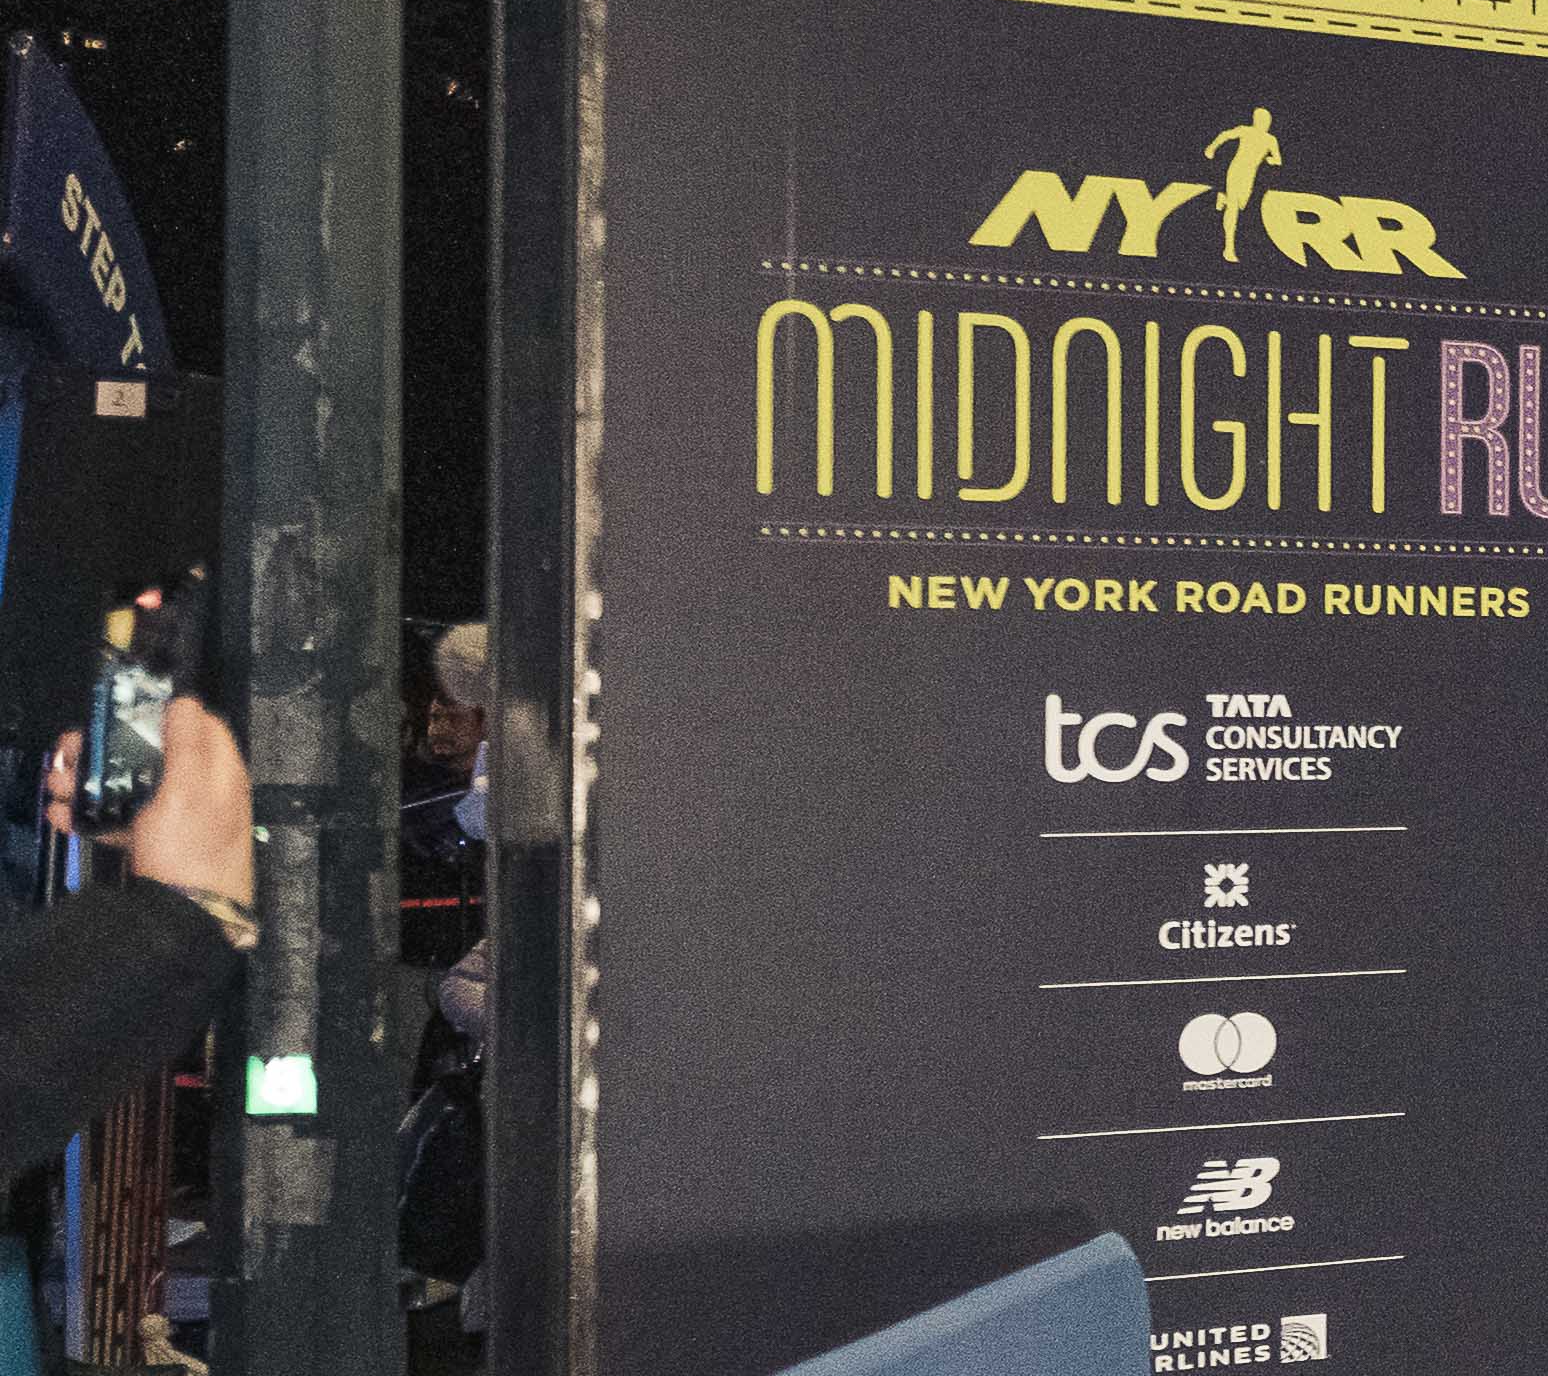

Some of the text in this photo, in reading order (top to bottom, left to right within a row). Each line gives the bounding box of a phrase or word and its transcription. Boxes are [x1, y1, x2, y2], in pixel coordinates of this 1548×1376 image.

[61, 173, 148, 370] STEP T
[756, 298, 1410, 513] MIDNIGHT
[888, 575, 1531, 618] NEW YORK ROAD RUNNERS
[1205, 694, 1293, 718] TATA
[1045, 694, 1190, 783] tcs
[1205, 725, 1403, 750] CONSULTANCY
[1205, 756, 1333, 782] SERVICES
[1158, 920, 1292, 950] Citizens
[1182, 1074, 1273, 1092] mastercard
[1156, 1214, 1295, 1242] new balance
[1150, 1323, 1272, 1351] UNITED
[1154, 1344, 1272, 1373] RLINES
